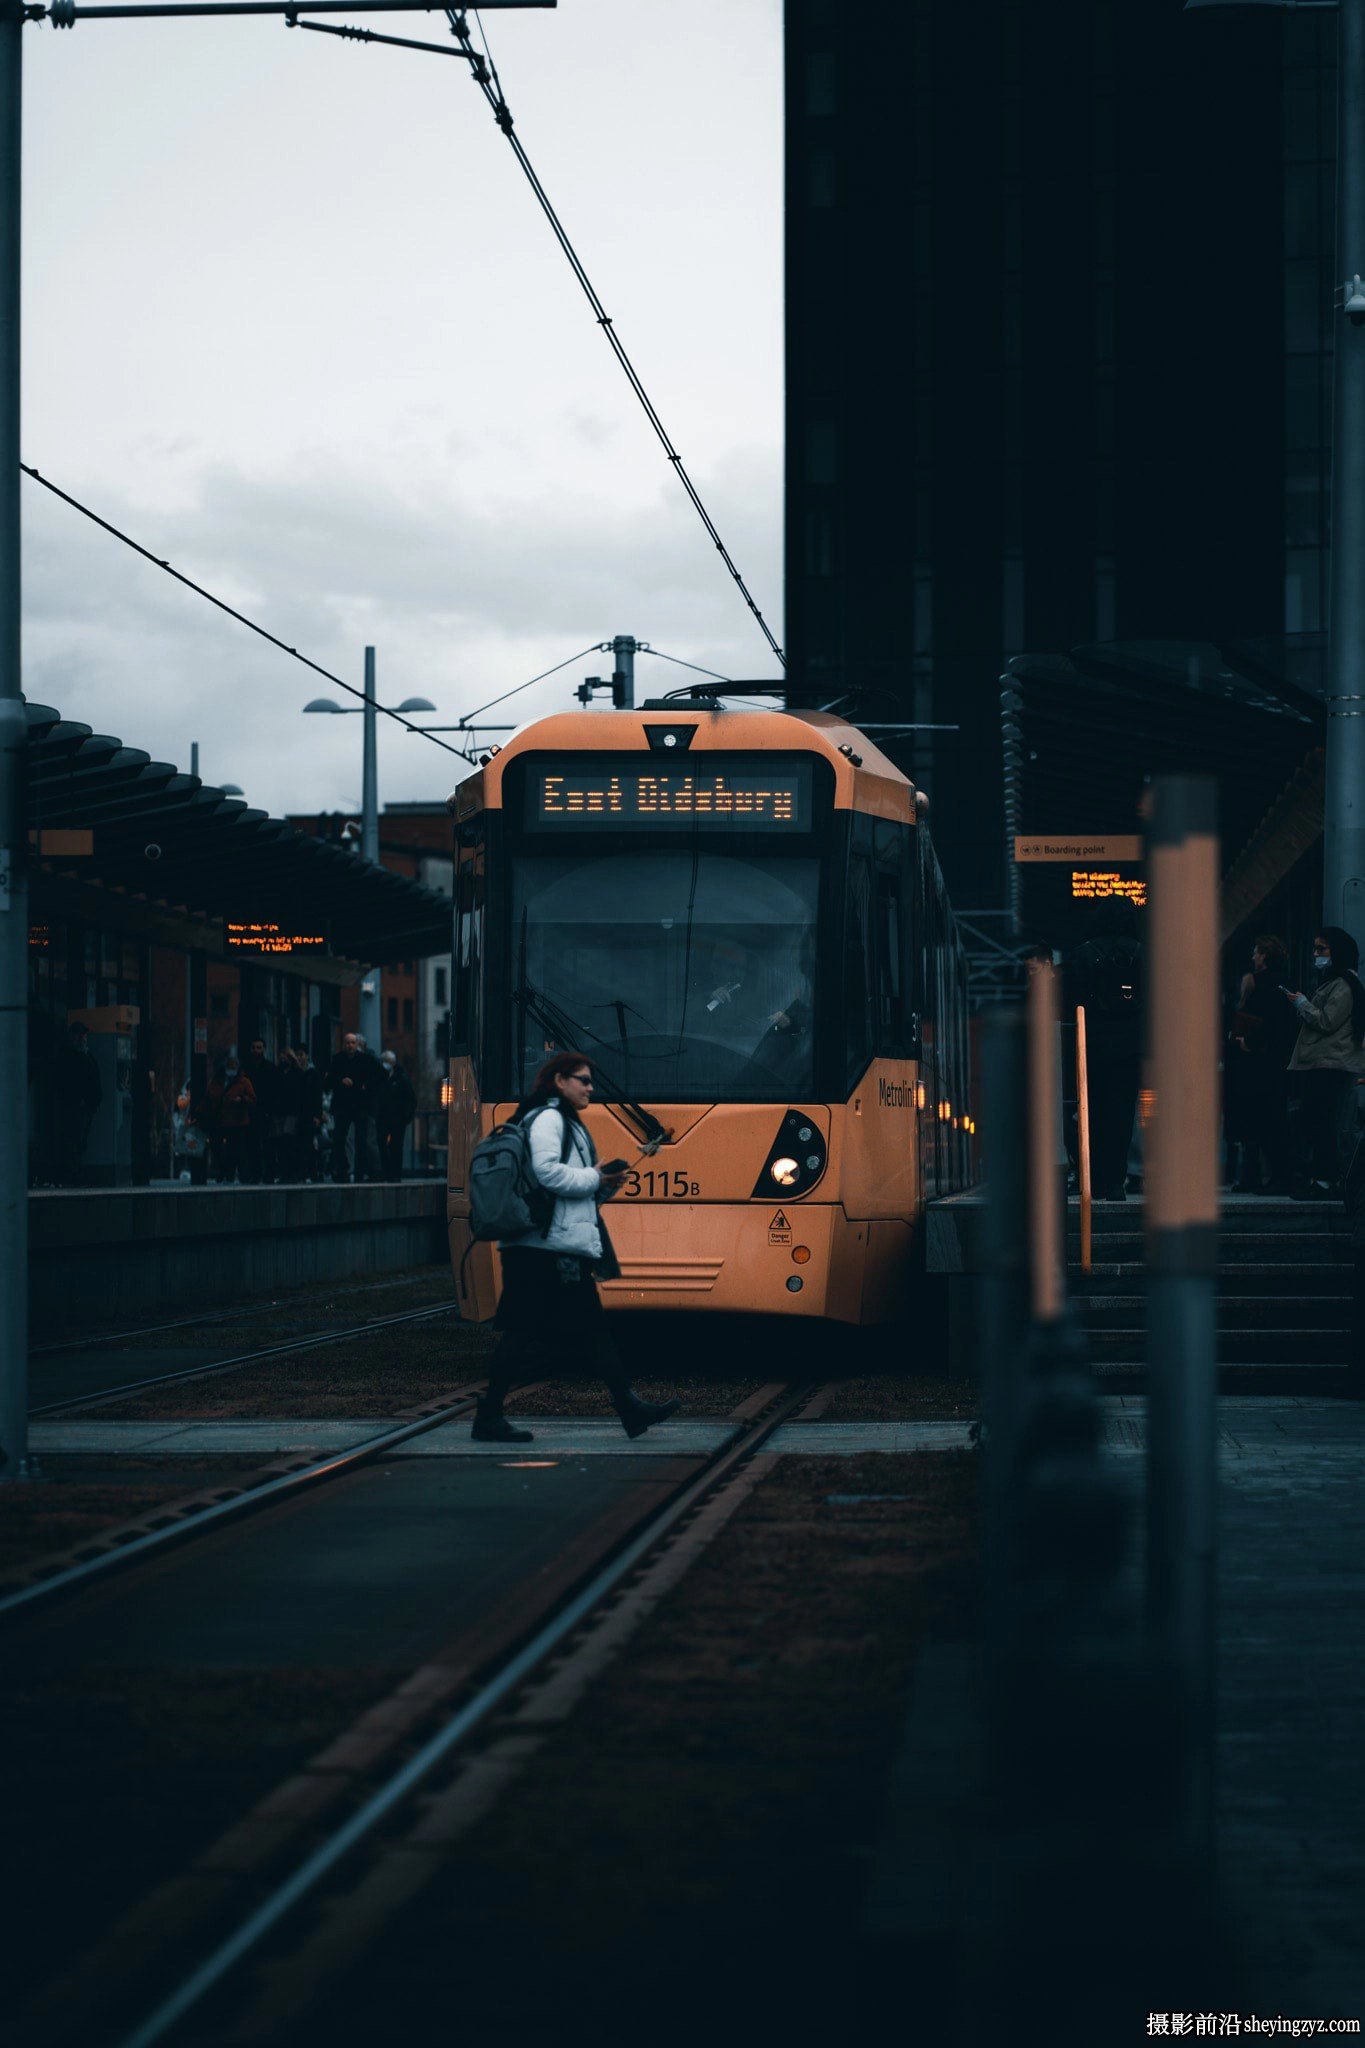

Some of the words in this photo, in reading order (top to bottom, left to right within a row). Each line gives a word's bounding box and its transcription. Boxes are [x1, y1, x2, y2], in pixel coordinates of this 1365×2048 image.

[544, 777, 623, 811] East
[1044, 845, 1082, 856] Boarding
[1082, 845, 1106, 856] point
